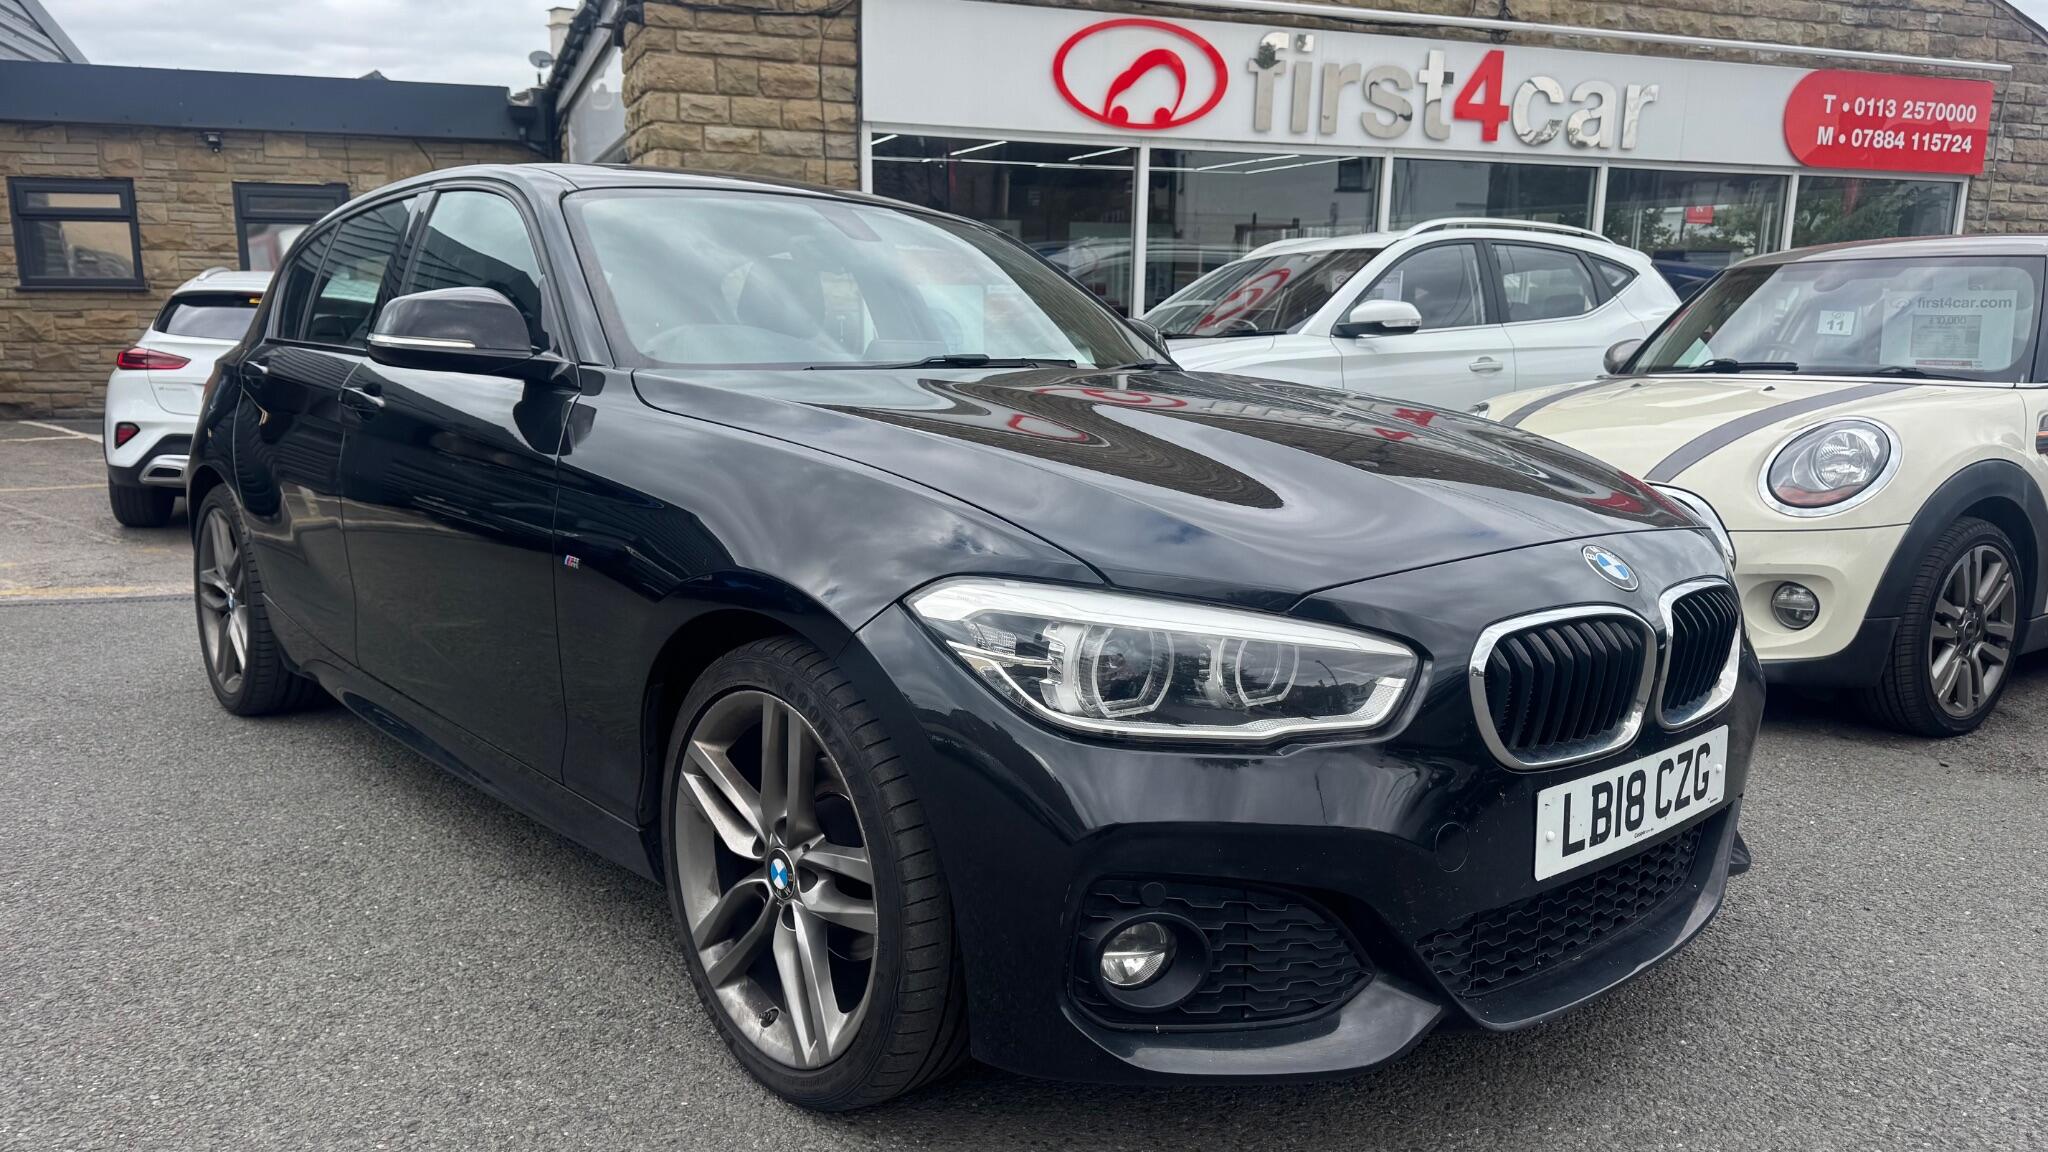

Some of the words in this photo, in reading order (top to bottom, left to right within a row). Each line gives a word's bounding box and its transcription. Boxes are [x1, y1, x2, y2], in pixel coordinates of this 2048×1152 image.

[1248, 31, 1659, 150] first4car
[1854, 97, 1896, 118] 0113
[1902, 101, 1977, 123] 2570000
[1851, 128, 1905, 149] 07884
[1911, 132, 1972, 153] 115724
[1917, 297, 2013, 309] first4car.com
[1562, 769, 1646, 858] LB18
[1655, 742, 1711, 819] CZG
